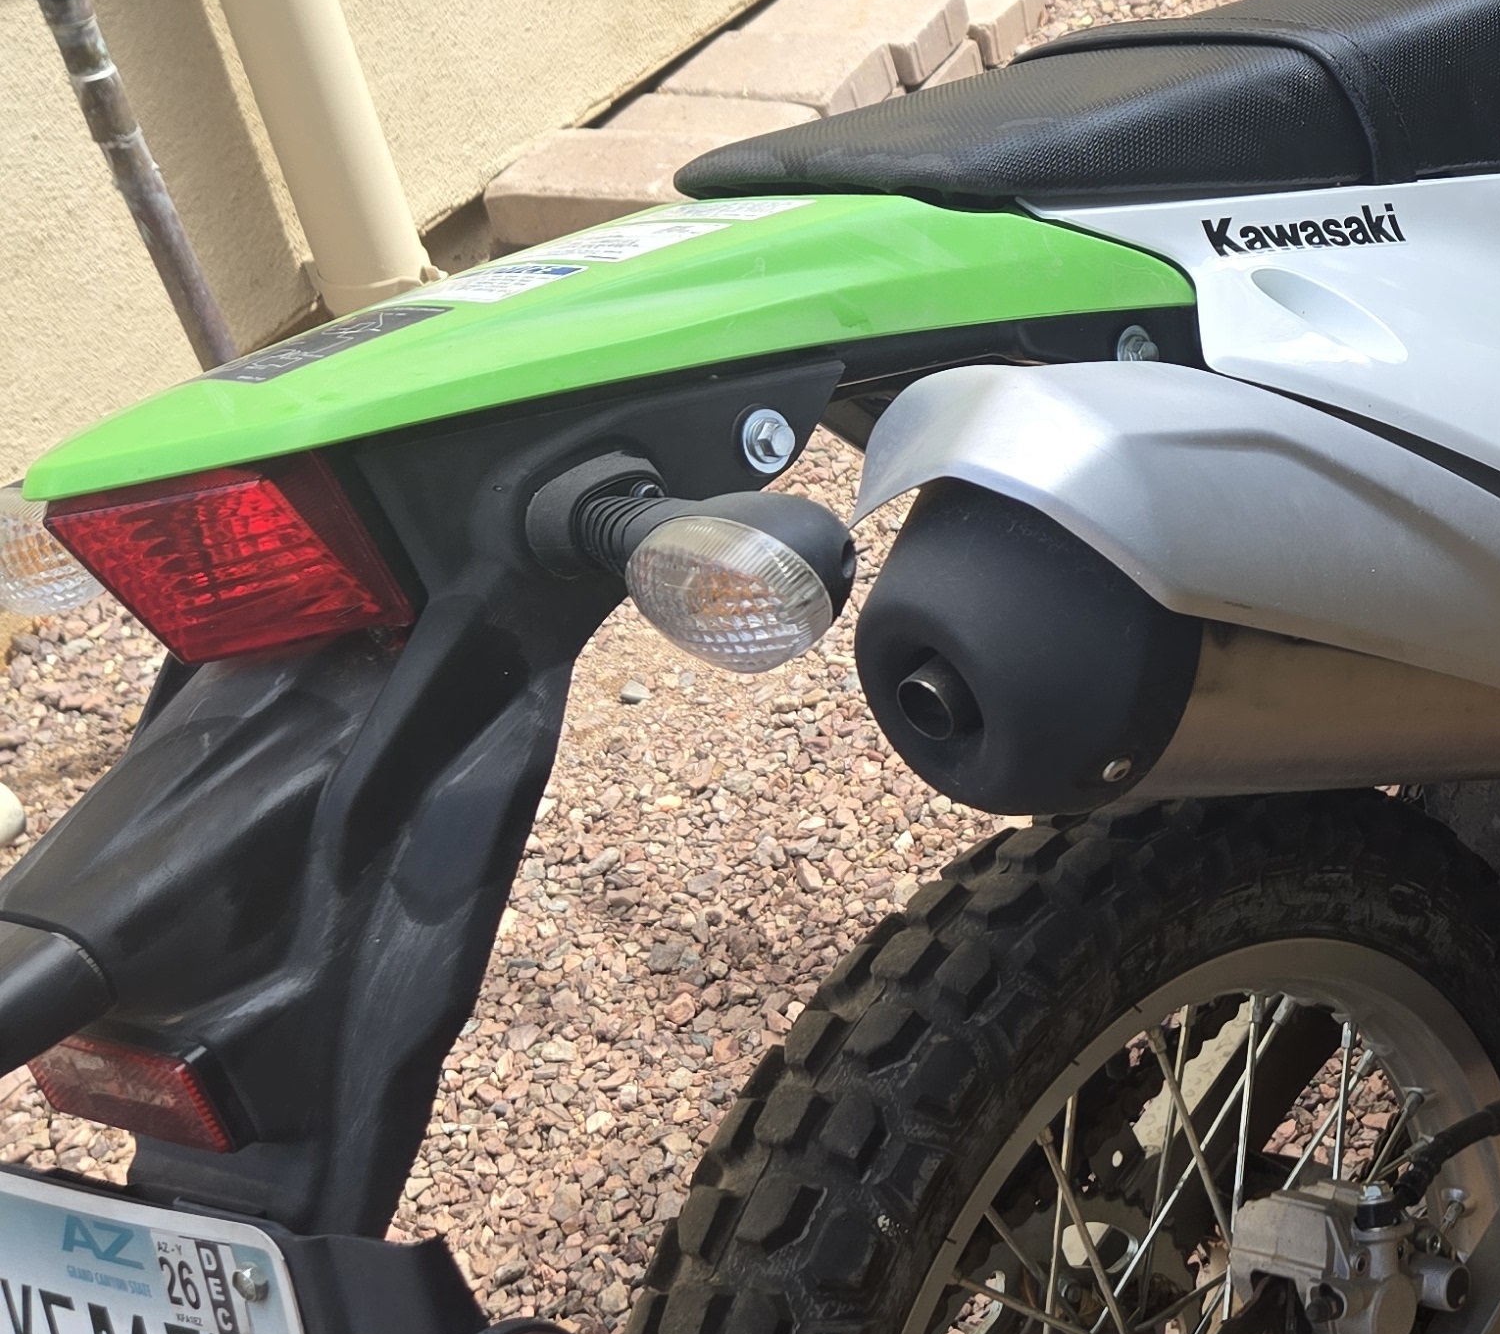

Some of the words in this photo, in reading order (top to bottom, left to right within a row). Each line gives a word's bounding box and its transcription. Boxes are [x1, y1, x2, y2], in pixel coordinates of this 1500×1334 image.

[1201, 203, 1407, 257] Kawasaki
[62, 1214, 146, 1270] AZ
[158, 1256, 202, 1311] 26
[199, 1247, 233, 1332] DEC
